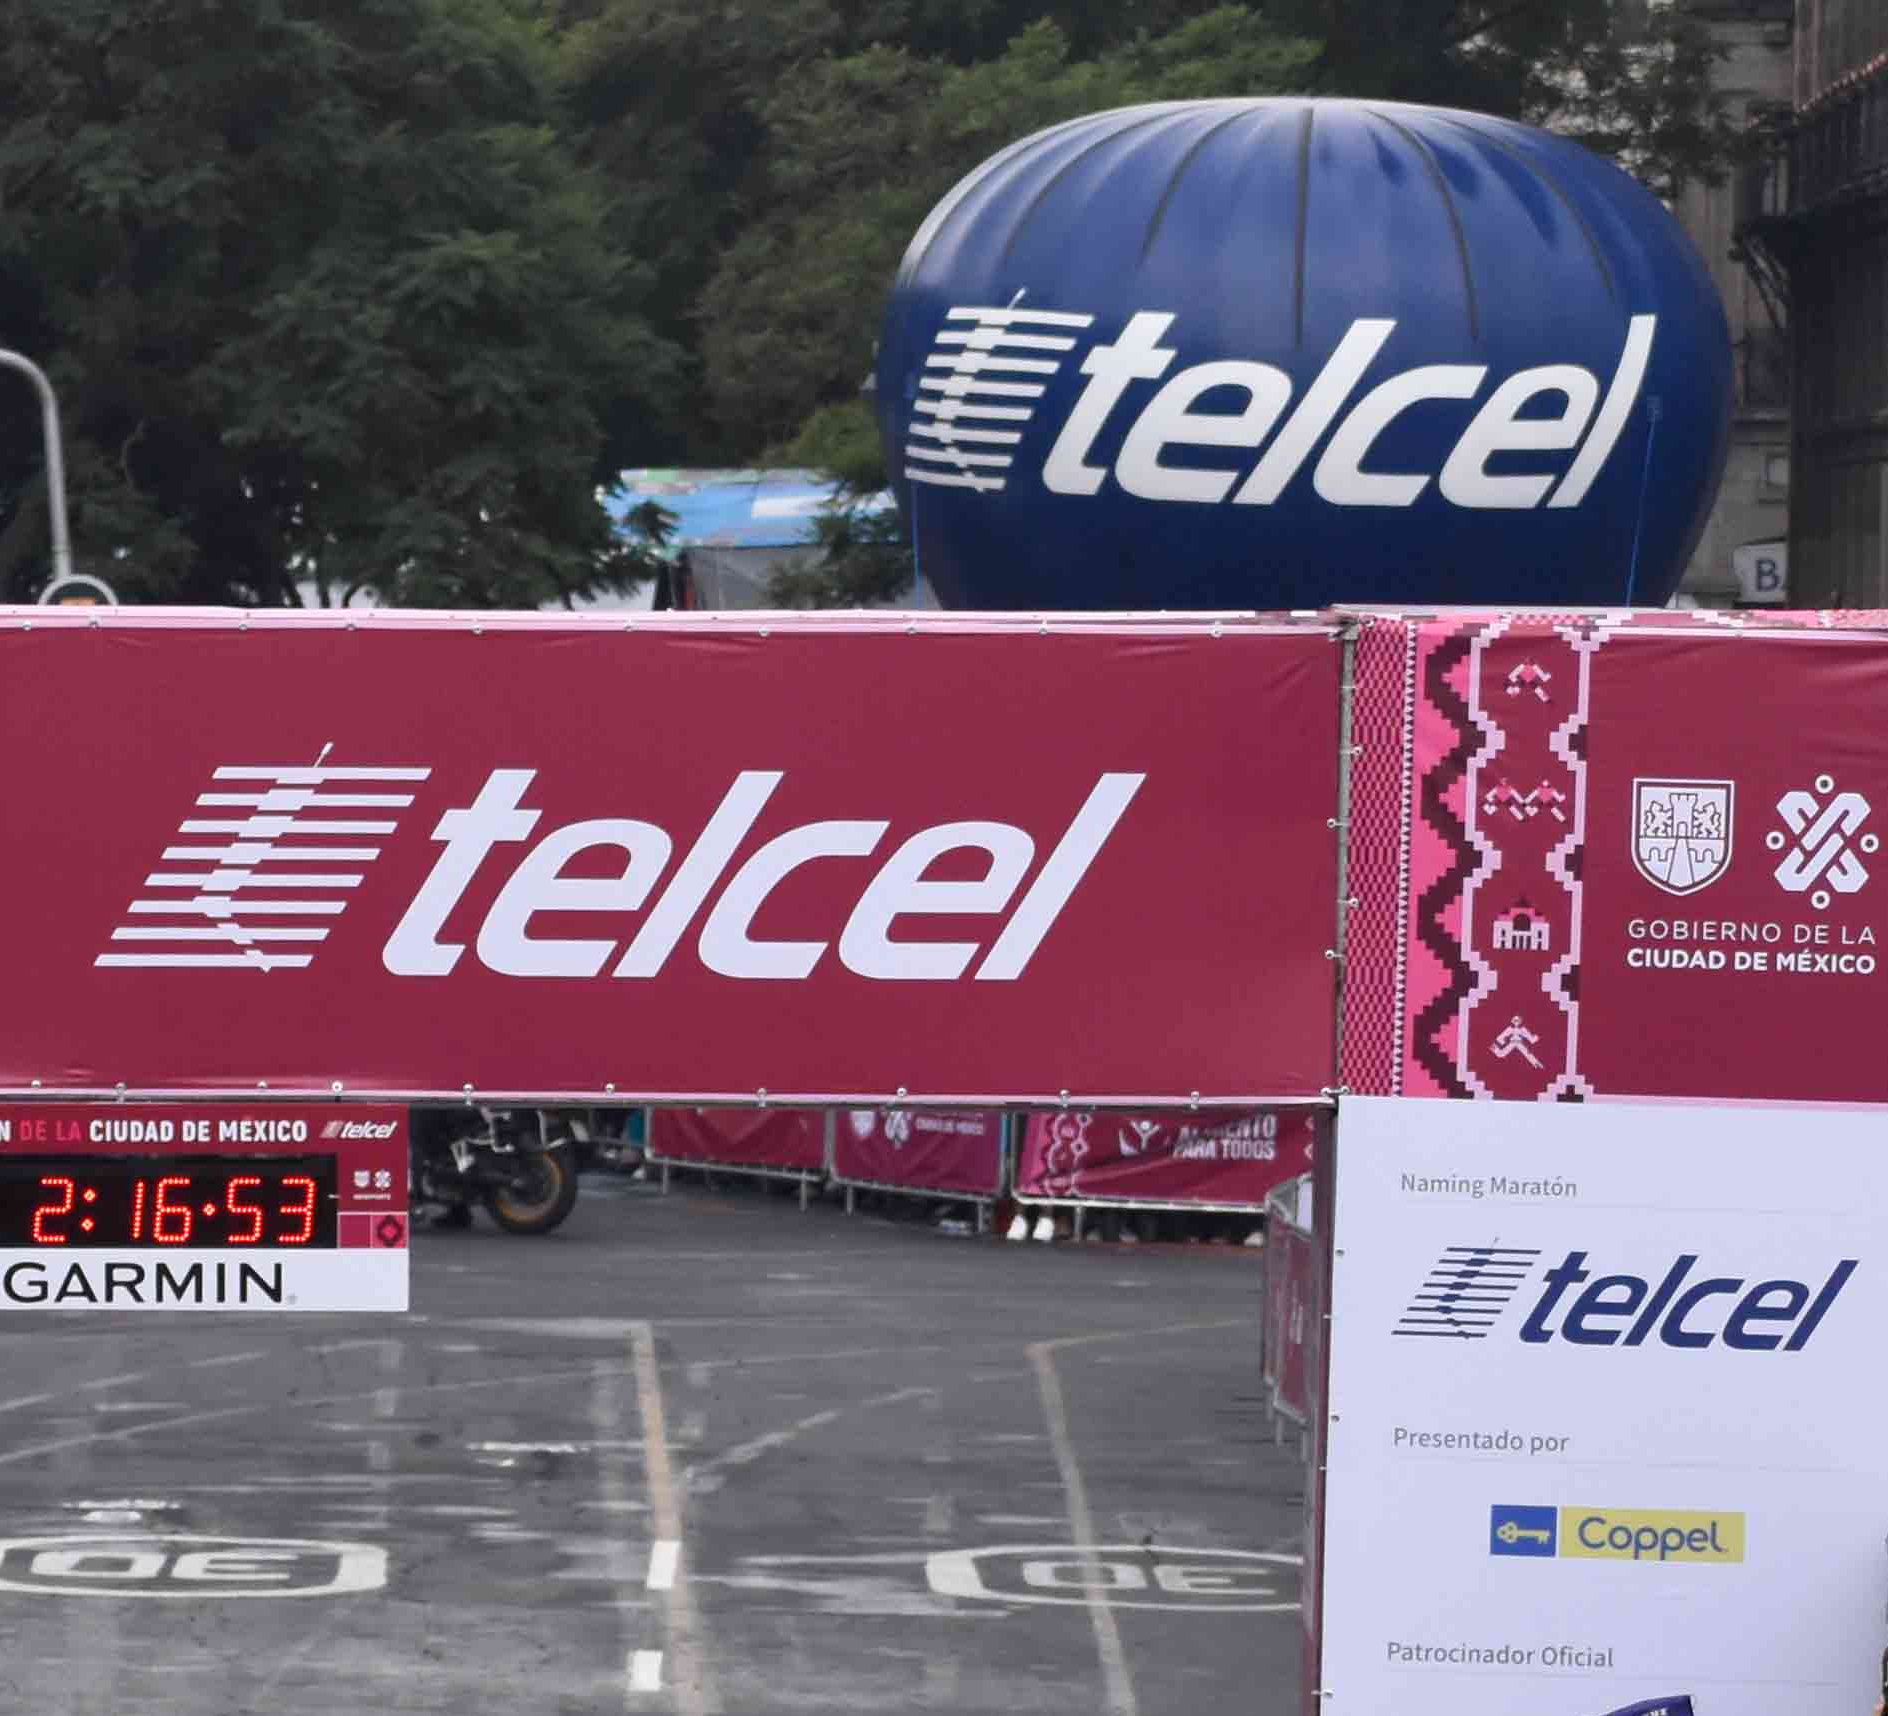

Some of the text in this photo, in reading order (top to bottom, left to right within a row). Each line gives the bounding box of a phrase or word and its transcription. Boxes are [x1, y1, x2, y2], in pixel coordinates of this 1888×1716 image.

[1043, 310, 1657, 510] telcel
[382, 768, 1146, 980] telcel
[1628, 920, 1875, 945] GOBIERNO DE LA
[1627, 949, 1876, 974] CIUDAD DE MÉXICO
[19, 1120, 47, 1142] DE
[55, 1120, 82, 1142] LA
[89, 1120, 174, 1143] CIUDAD
[182, 1120, 211, 1143] DE
[337, 1120, 397, 1140] telcel
[1401, 1173, 1577, 1198] Naming Maratón
[2, 1262, 283, 1304] GARMIN
[1518, 1251, 1860, 1352] telcel
[1393, 1428, 1569, 1455] Presentado por
[1578, 1516, 1723, 1561] Coppel
[1387, 1642, 1614, 1668] Patrocinador Oficial
